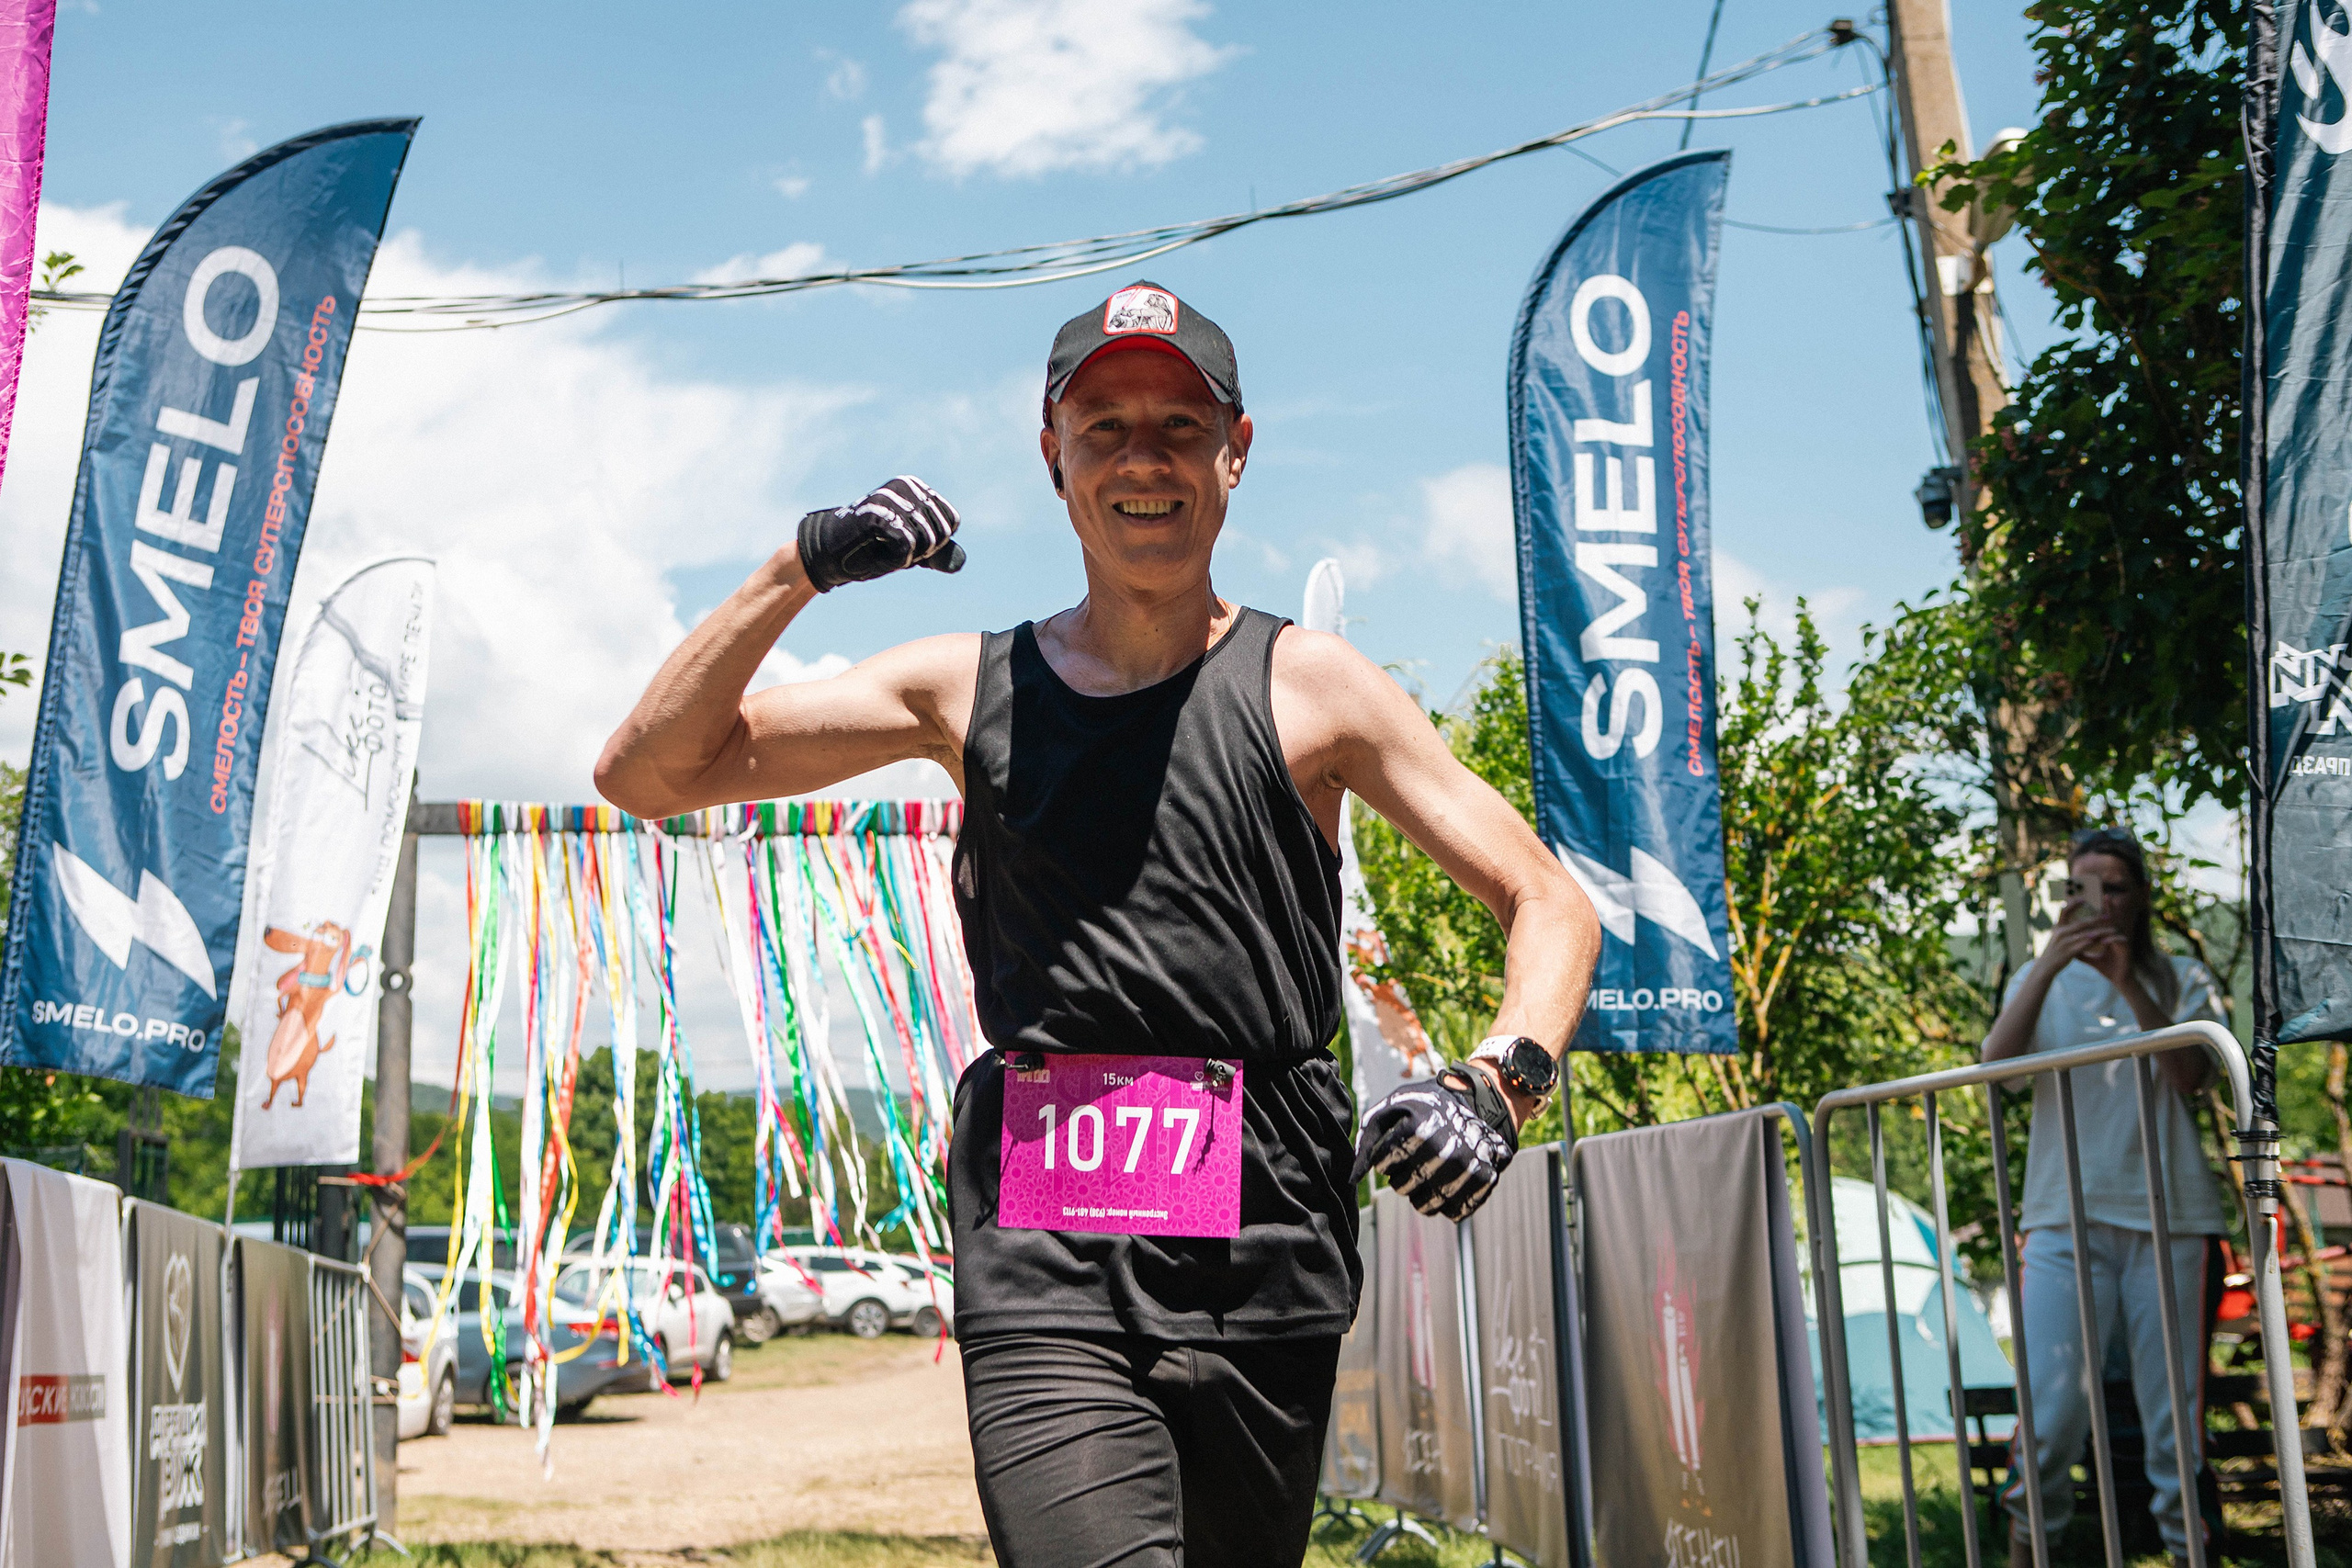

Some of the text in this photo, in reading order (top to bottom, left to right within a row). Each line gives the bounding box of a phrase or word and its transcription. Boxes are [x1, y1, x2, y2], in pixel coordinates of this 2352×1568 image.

[111, 246, 279, 781] SMELO
[236, 580, 266, 648] ТВОЯ
[254, 295, 336, 576] СУПЕРСПОСОБНОСТЬ
[1570, 274, 1663, 761] SMELO
[1670, 310, 1690, 557] СУПЕРСПОСОБНОСТЬ
[1678, 560, 1696, 621] ТВОЯ
[32, 998, 207, 1055] SMELO.PRO
[1038, 1103, 1201, 1175] 1077
